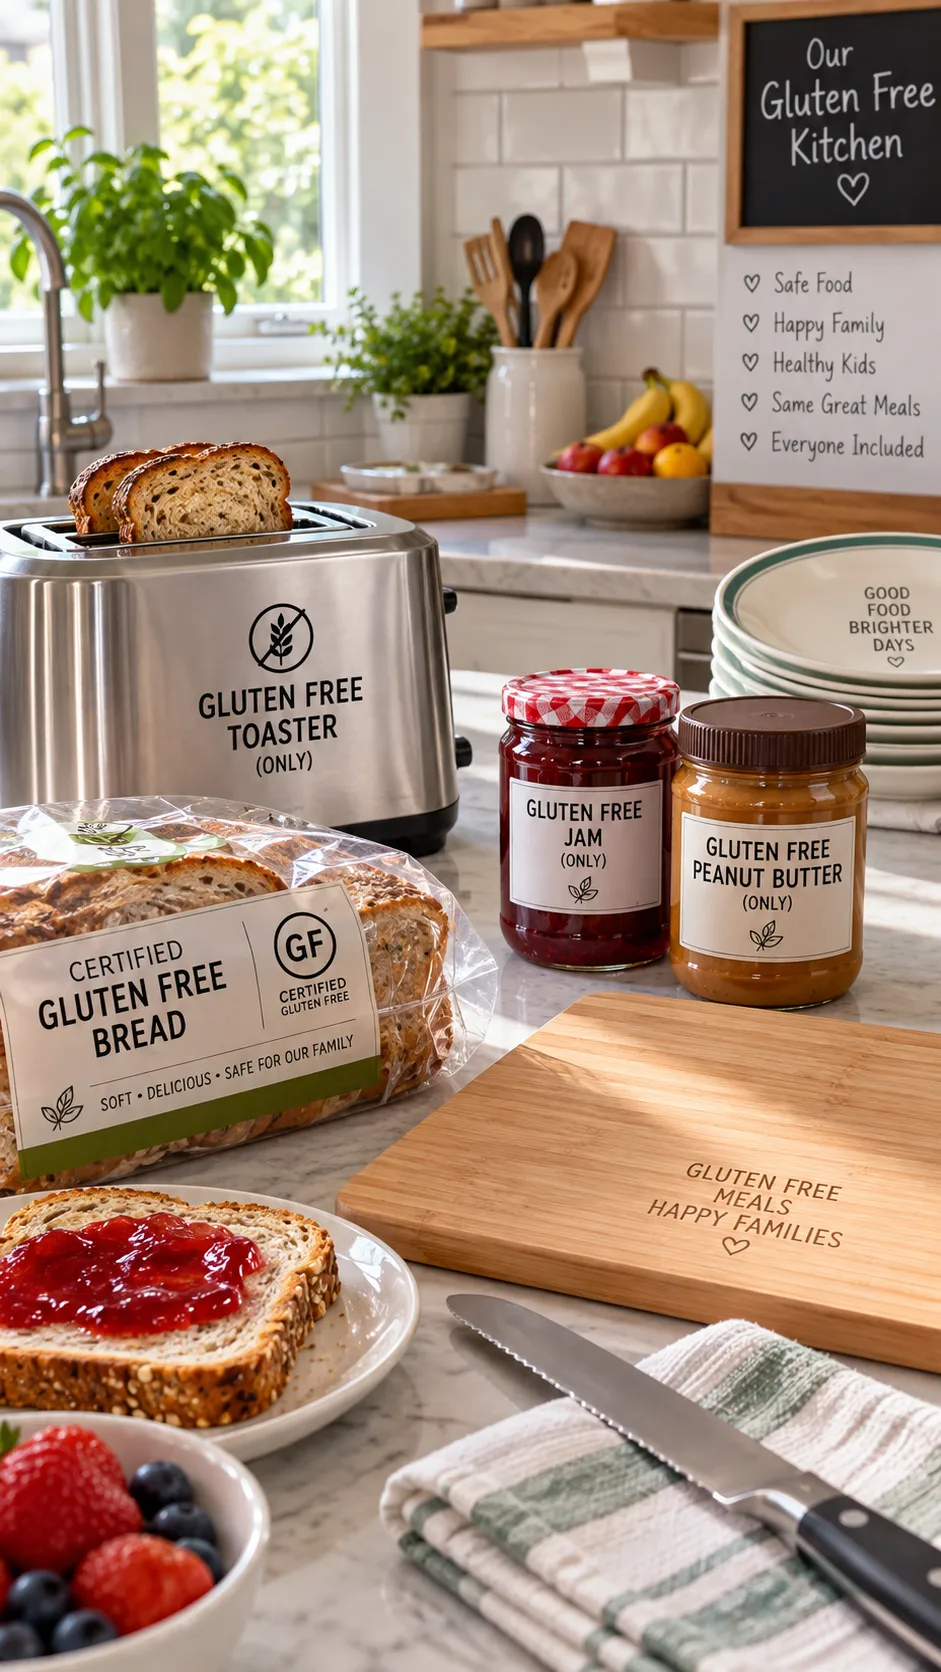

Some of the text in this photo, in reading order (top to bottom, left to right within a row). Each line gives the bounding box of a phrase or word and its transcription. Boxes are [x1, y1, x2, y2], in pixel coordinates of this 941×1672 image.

[806, 36, 854, 70] Our
[760, 70, 937, 120] Gluten Free
[791, 123, 903, 166] Kitchen
[774, 271, 853, 294] Safe Food
[774, 312, 885, 343] Happy Family
[773, 351, 876, 382] Healthy Kids
[772, 391, 921, 417] Same Great Meals
[771, 431, 925, 461] Everyone Included
[864, 586, 910, 600] GOOD
[867, 603, 911, 617] FOOD
[848, 619, 934, 635] BRIGHTER
[872, 638, 915, 652] DAYS
[198, 676, 363, 719] GLUTEN FREE
[227, 713, 338, 751] TOASTER
[256, 750, 313, 778] (ONLY)
[526, 798, 643, 822] GLUTEN FREE
[564, 828, 602, 848] JAM
[705, 836, 830, 862] GLUTEN FREE
[560, 852, 607, 870] (ONLY)
[692, 859, 843, 889] PEANUT BUTTER
[741, 895, 793, 913] (ONLY)
[285, 928, 325, 963] GF
[68, 939, 183, 983] CERTIFIED
[38, 960, 227, 1030] GLUTEN FREE
[278, 977, 348, 1004] CERTIFIED
[280, 991, 350, 1017] GLUTEN FREE
[92, 1009, 187, 1059] BREAD
[100, 1034, 354, 1112] SOFT DELICIOUS SAFE FOR OUR FAMILY
[686, 1162, 843, 1202] GLUTEN FREE
[713, 1187, 793, 1216] MEALS
[647, 1199, 844, 1248] HAPPY FAMILIES
